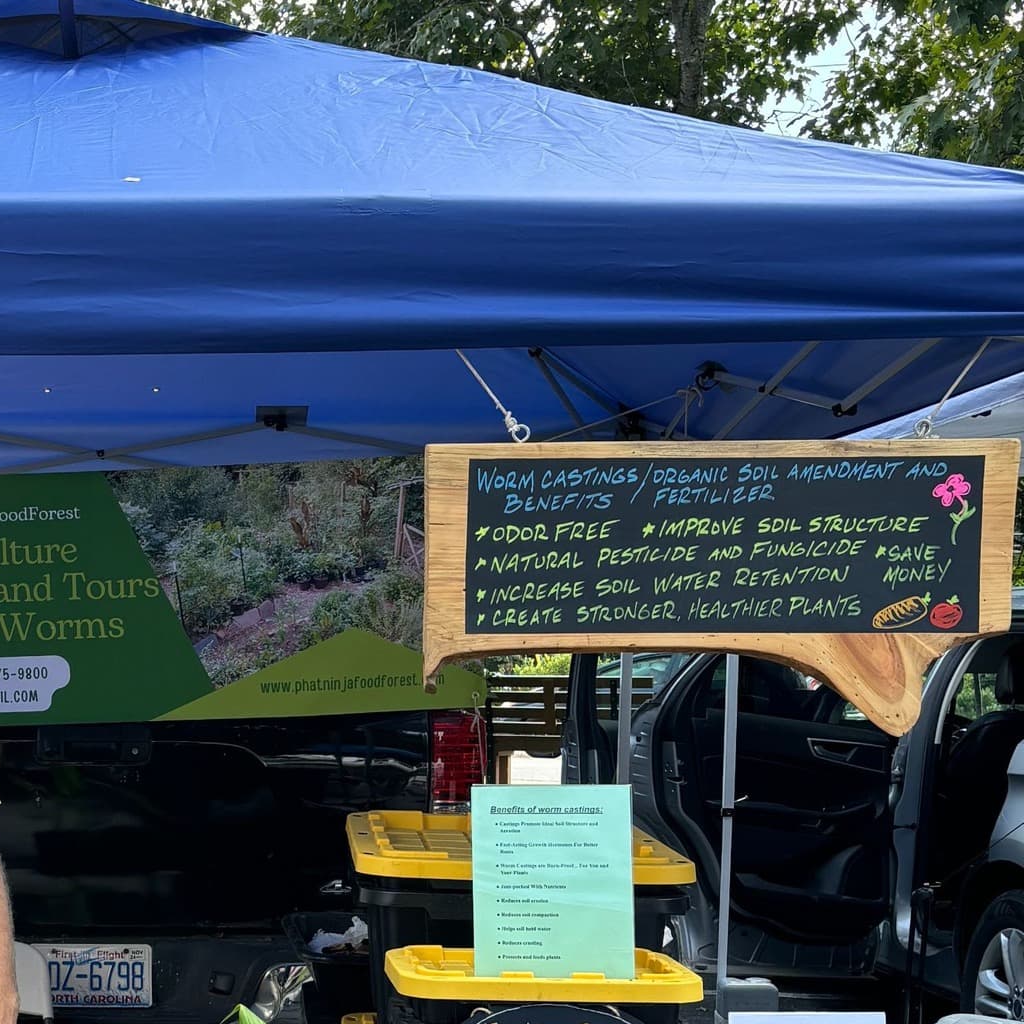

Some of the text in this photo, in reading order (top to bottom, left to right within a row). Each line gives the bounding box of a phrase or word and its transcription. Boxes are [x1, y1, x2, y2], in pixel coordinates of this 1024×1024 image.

[477, 460, 947, 494] WORM CASTINGS ORGANIC SOIL AMENDMENT AND
[503, 484, 775, 514] BENEFITS FERTILIZER
[493, 514, 929, 543] ODOR FREE IMPROVE SOIL STRUCTURE
[490, 539, 866, 574] NATURAL PESTICIDE AND FUNGICIDE
[888, 544, 941, 562] SAVE
[62, 571, 159, 600] Tours
[490, 566, 850, 605] INCREASE SOIL WATER RETENTION
[883, 558, 951, 590] MONEY
[493, 607, 563, 627] CREATE
[688, 597, 781, 620] HEALTHIER
[788, 594, 862, 617] PLANTS
[260, 673, 445, 695] www.phatninjafoodforest.m
[490, 806, 525, 815] Benefits
[528, 806, 537, 815] of
[538, 807, 562, 815] worm
[84, 994, 142, 1005] CAROLINA
